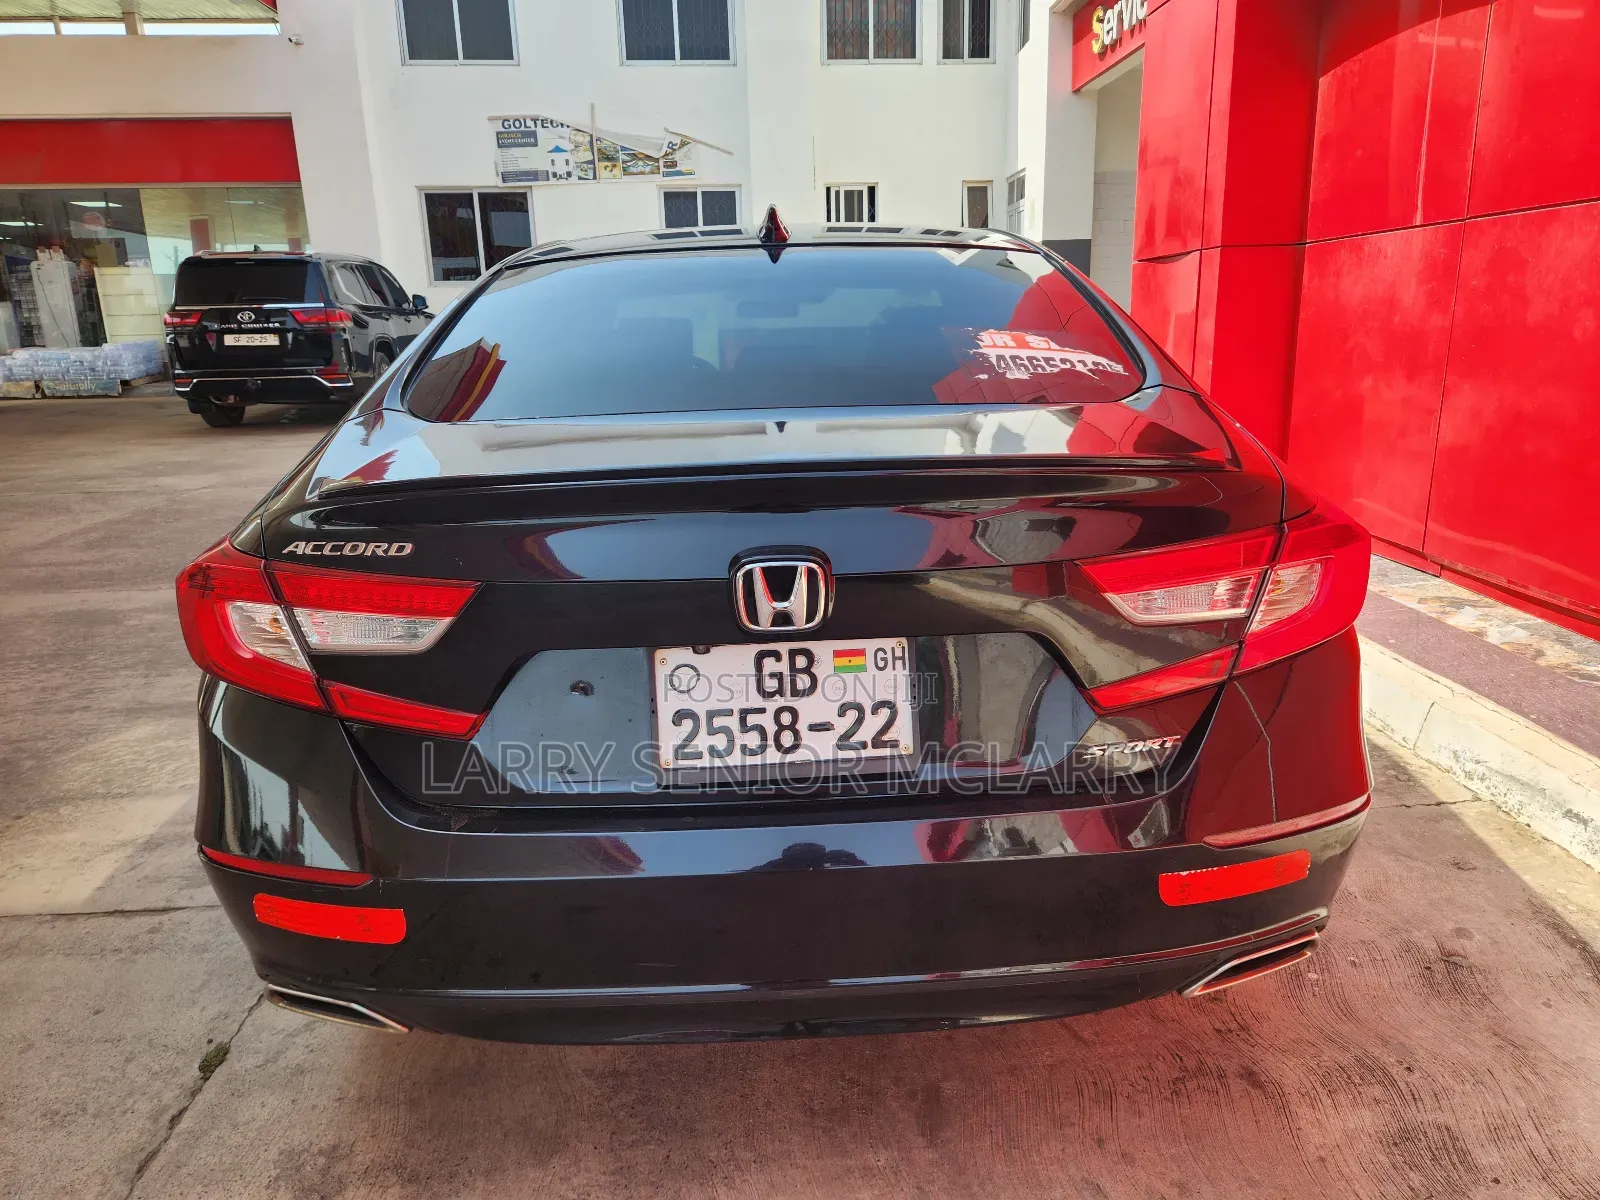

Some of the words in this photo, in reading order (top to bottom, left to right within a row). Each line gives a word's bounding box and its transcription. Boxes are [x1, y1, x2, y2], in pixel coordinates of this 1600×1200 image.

[233, 336, 241, 344] SF
[246, 335, 268, 344] 20-25
[281, 541, 414, 557] ACCORD
[753, 648, 818, 699] GB
[873, 645, 907, 672] GH
[671, 699, 901, 760] 2558-22
[1082, 735, 1181, 759] SPORT
